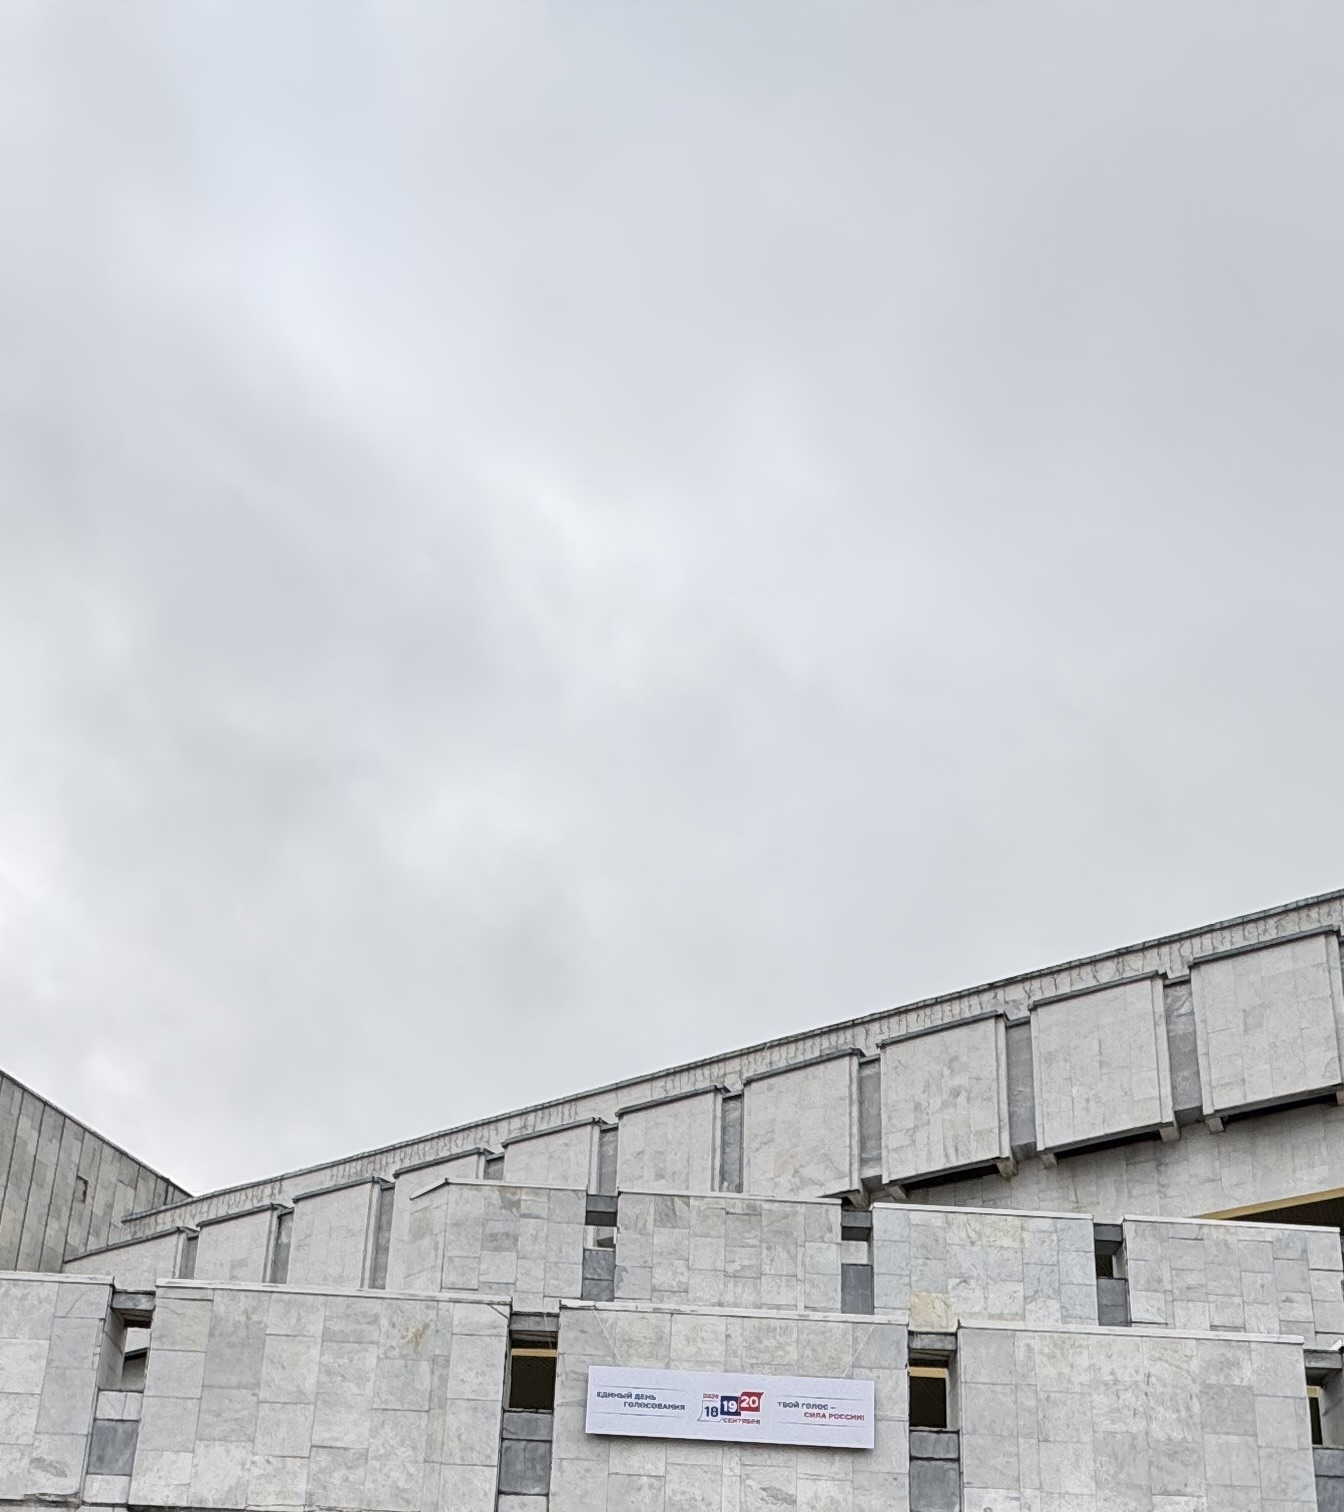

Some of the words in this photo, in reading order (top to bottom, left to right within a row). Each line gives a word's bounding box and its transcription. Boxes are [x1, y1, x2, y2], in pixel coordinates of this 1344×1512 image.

[596, 1391, 632, 1399] ЕДИНЫЙ
[624, 1401, 685, 1410] ГОЛОСОВАНИЯ
[704, 1406, 719, 1417] 18
[722, 1400, 738, 1412] 19
[740, 1395, 758, 1407] 20
[777, 1401, 799, 1409] ТВОЙ
[801, 1402, 828, 1410] ГОЛОС
[804, 1411, 826, 1419] СИЛА
